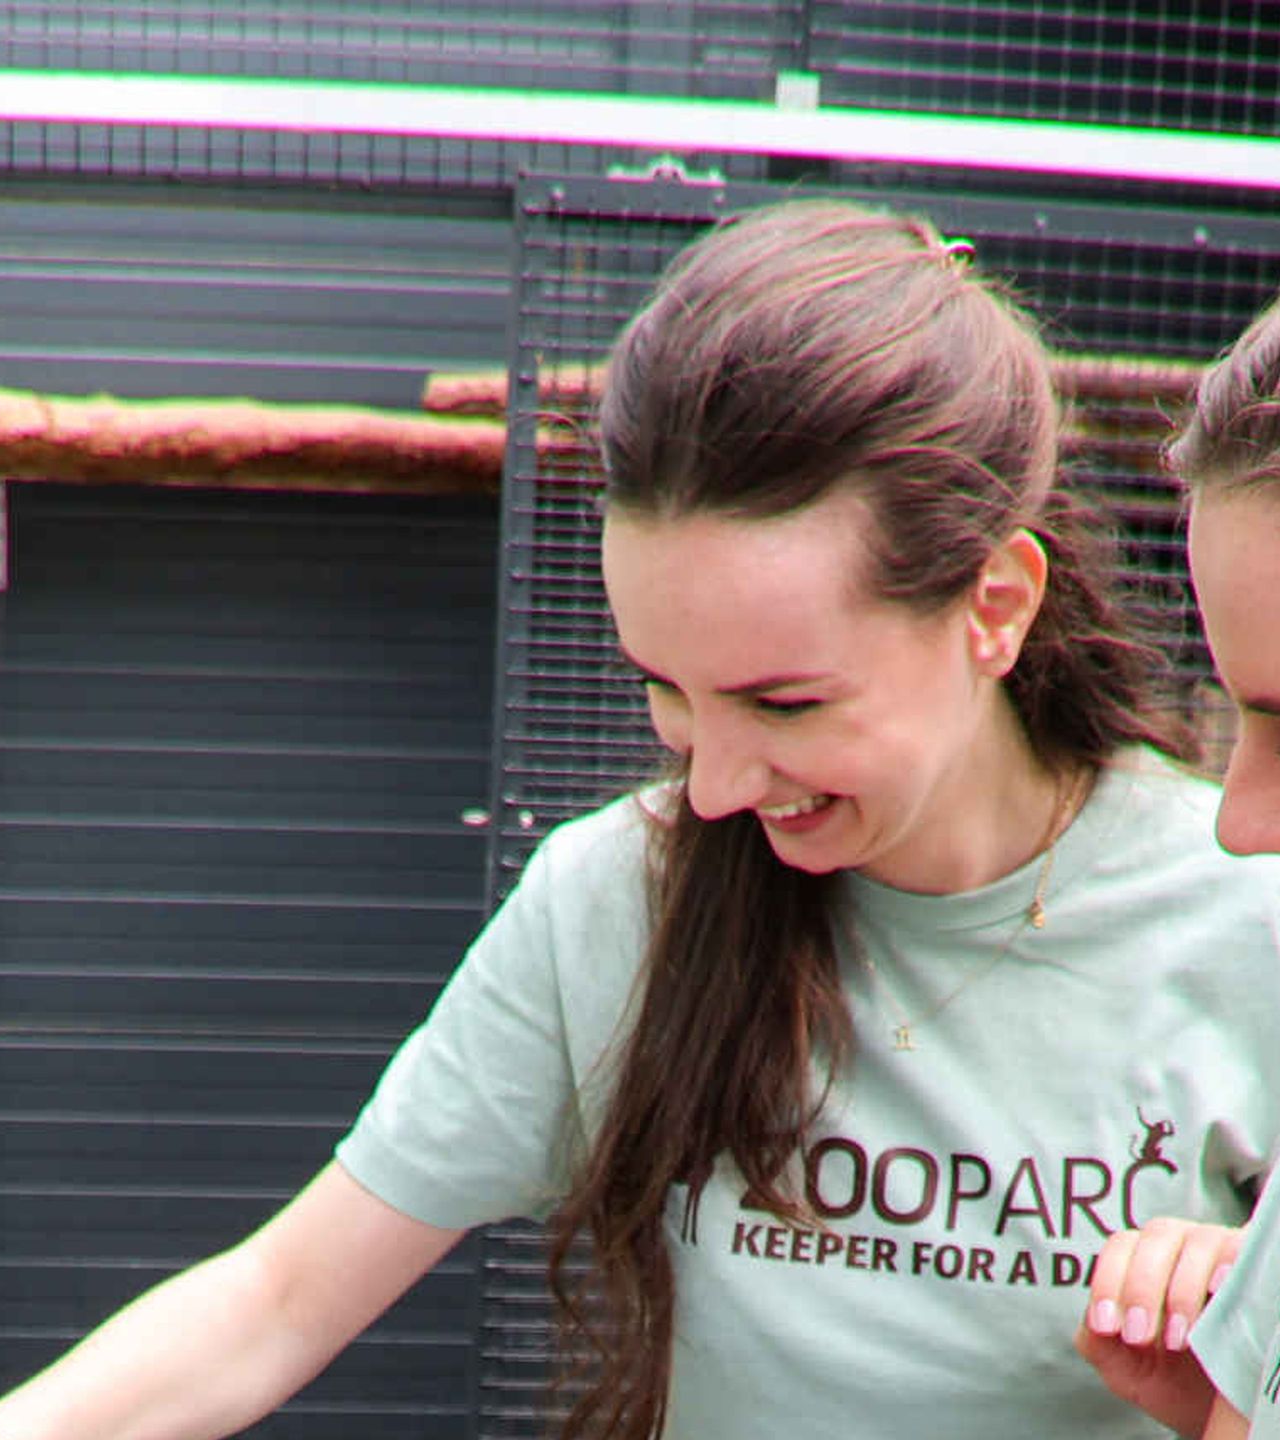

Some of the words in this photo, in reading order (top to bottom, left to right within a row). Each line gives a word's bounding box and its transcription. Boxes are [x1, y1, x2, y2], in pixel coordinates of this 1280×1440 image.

[731, 1222, 898, 1272] KEEPER
[911, 1241, 995, 1282] FOR
[1007, 1251, 1037, 1285] A
